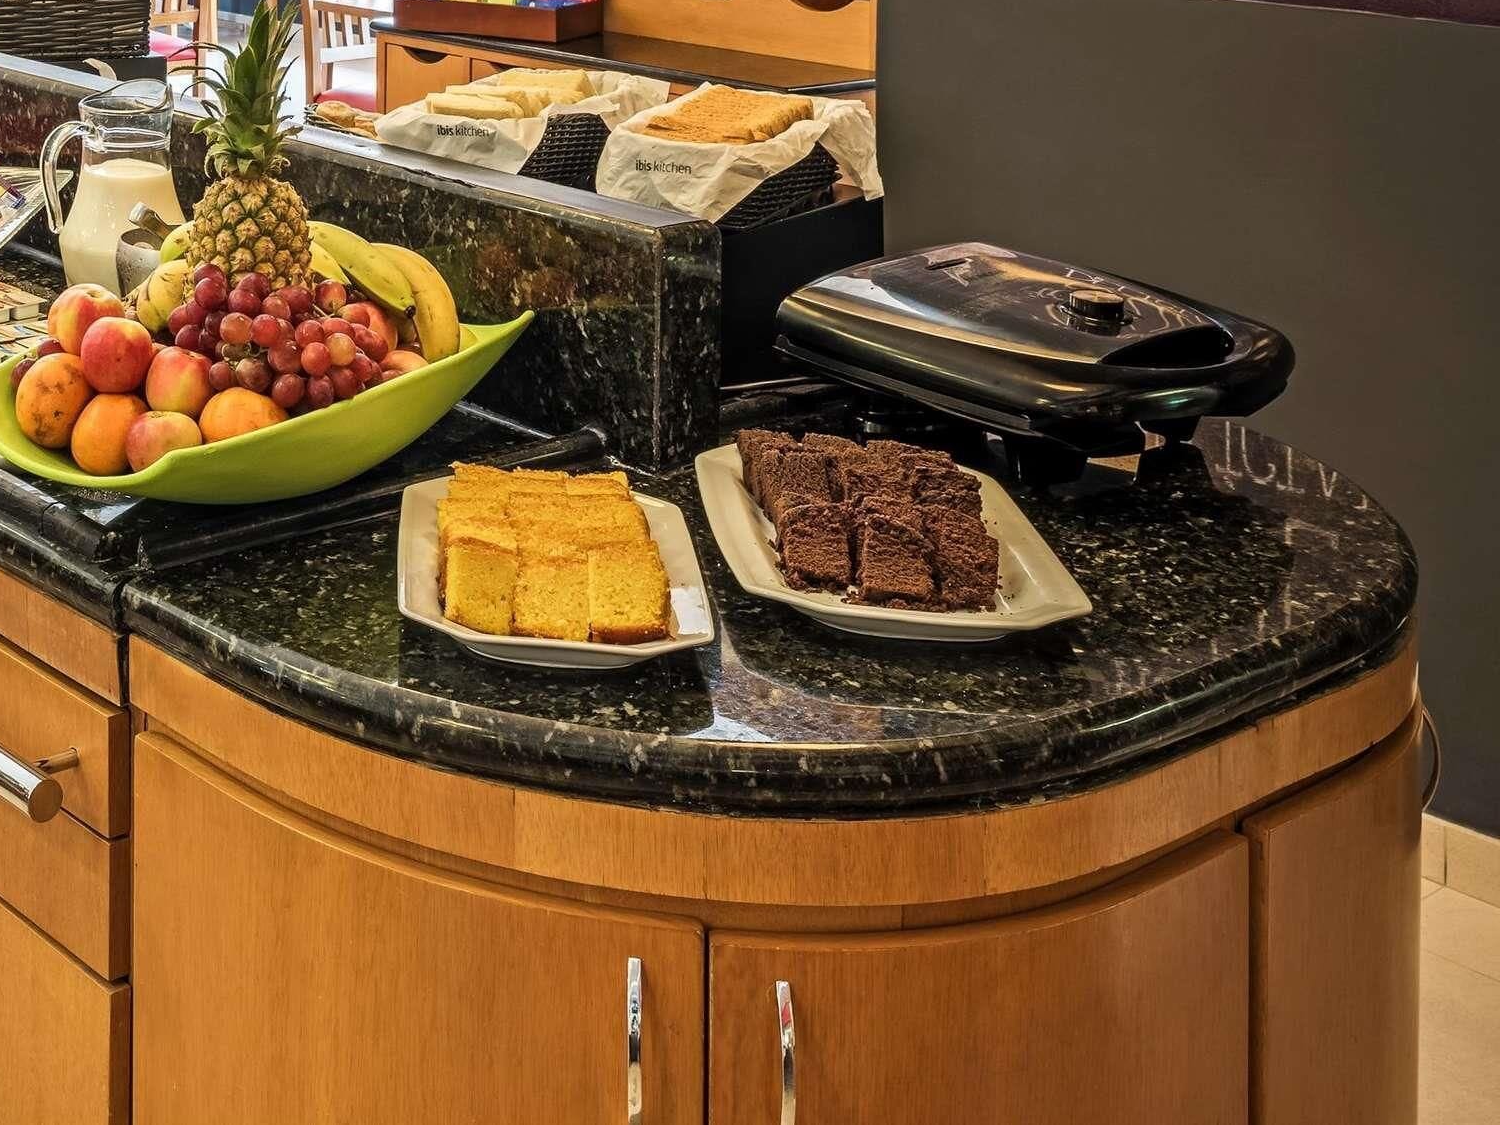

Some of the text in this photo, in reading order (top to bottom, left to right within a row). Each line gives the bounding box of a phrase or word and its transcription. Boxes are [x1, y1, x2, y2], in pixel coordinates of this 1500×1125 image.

[436, 124, 490, 137] ibis kitchen
[635, 159, 692, 175] ibis kitchen
